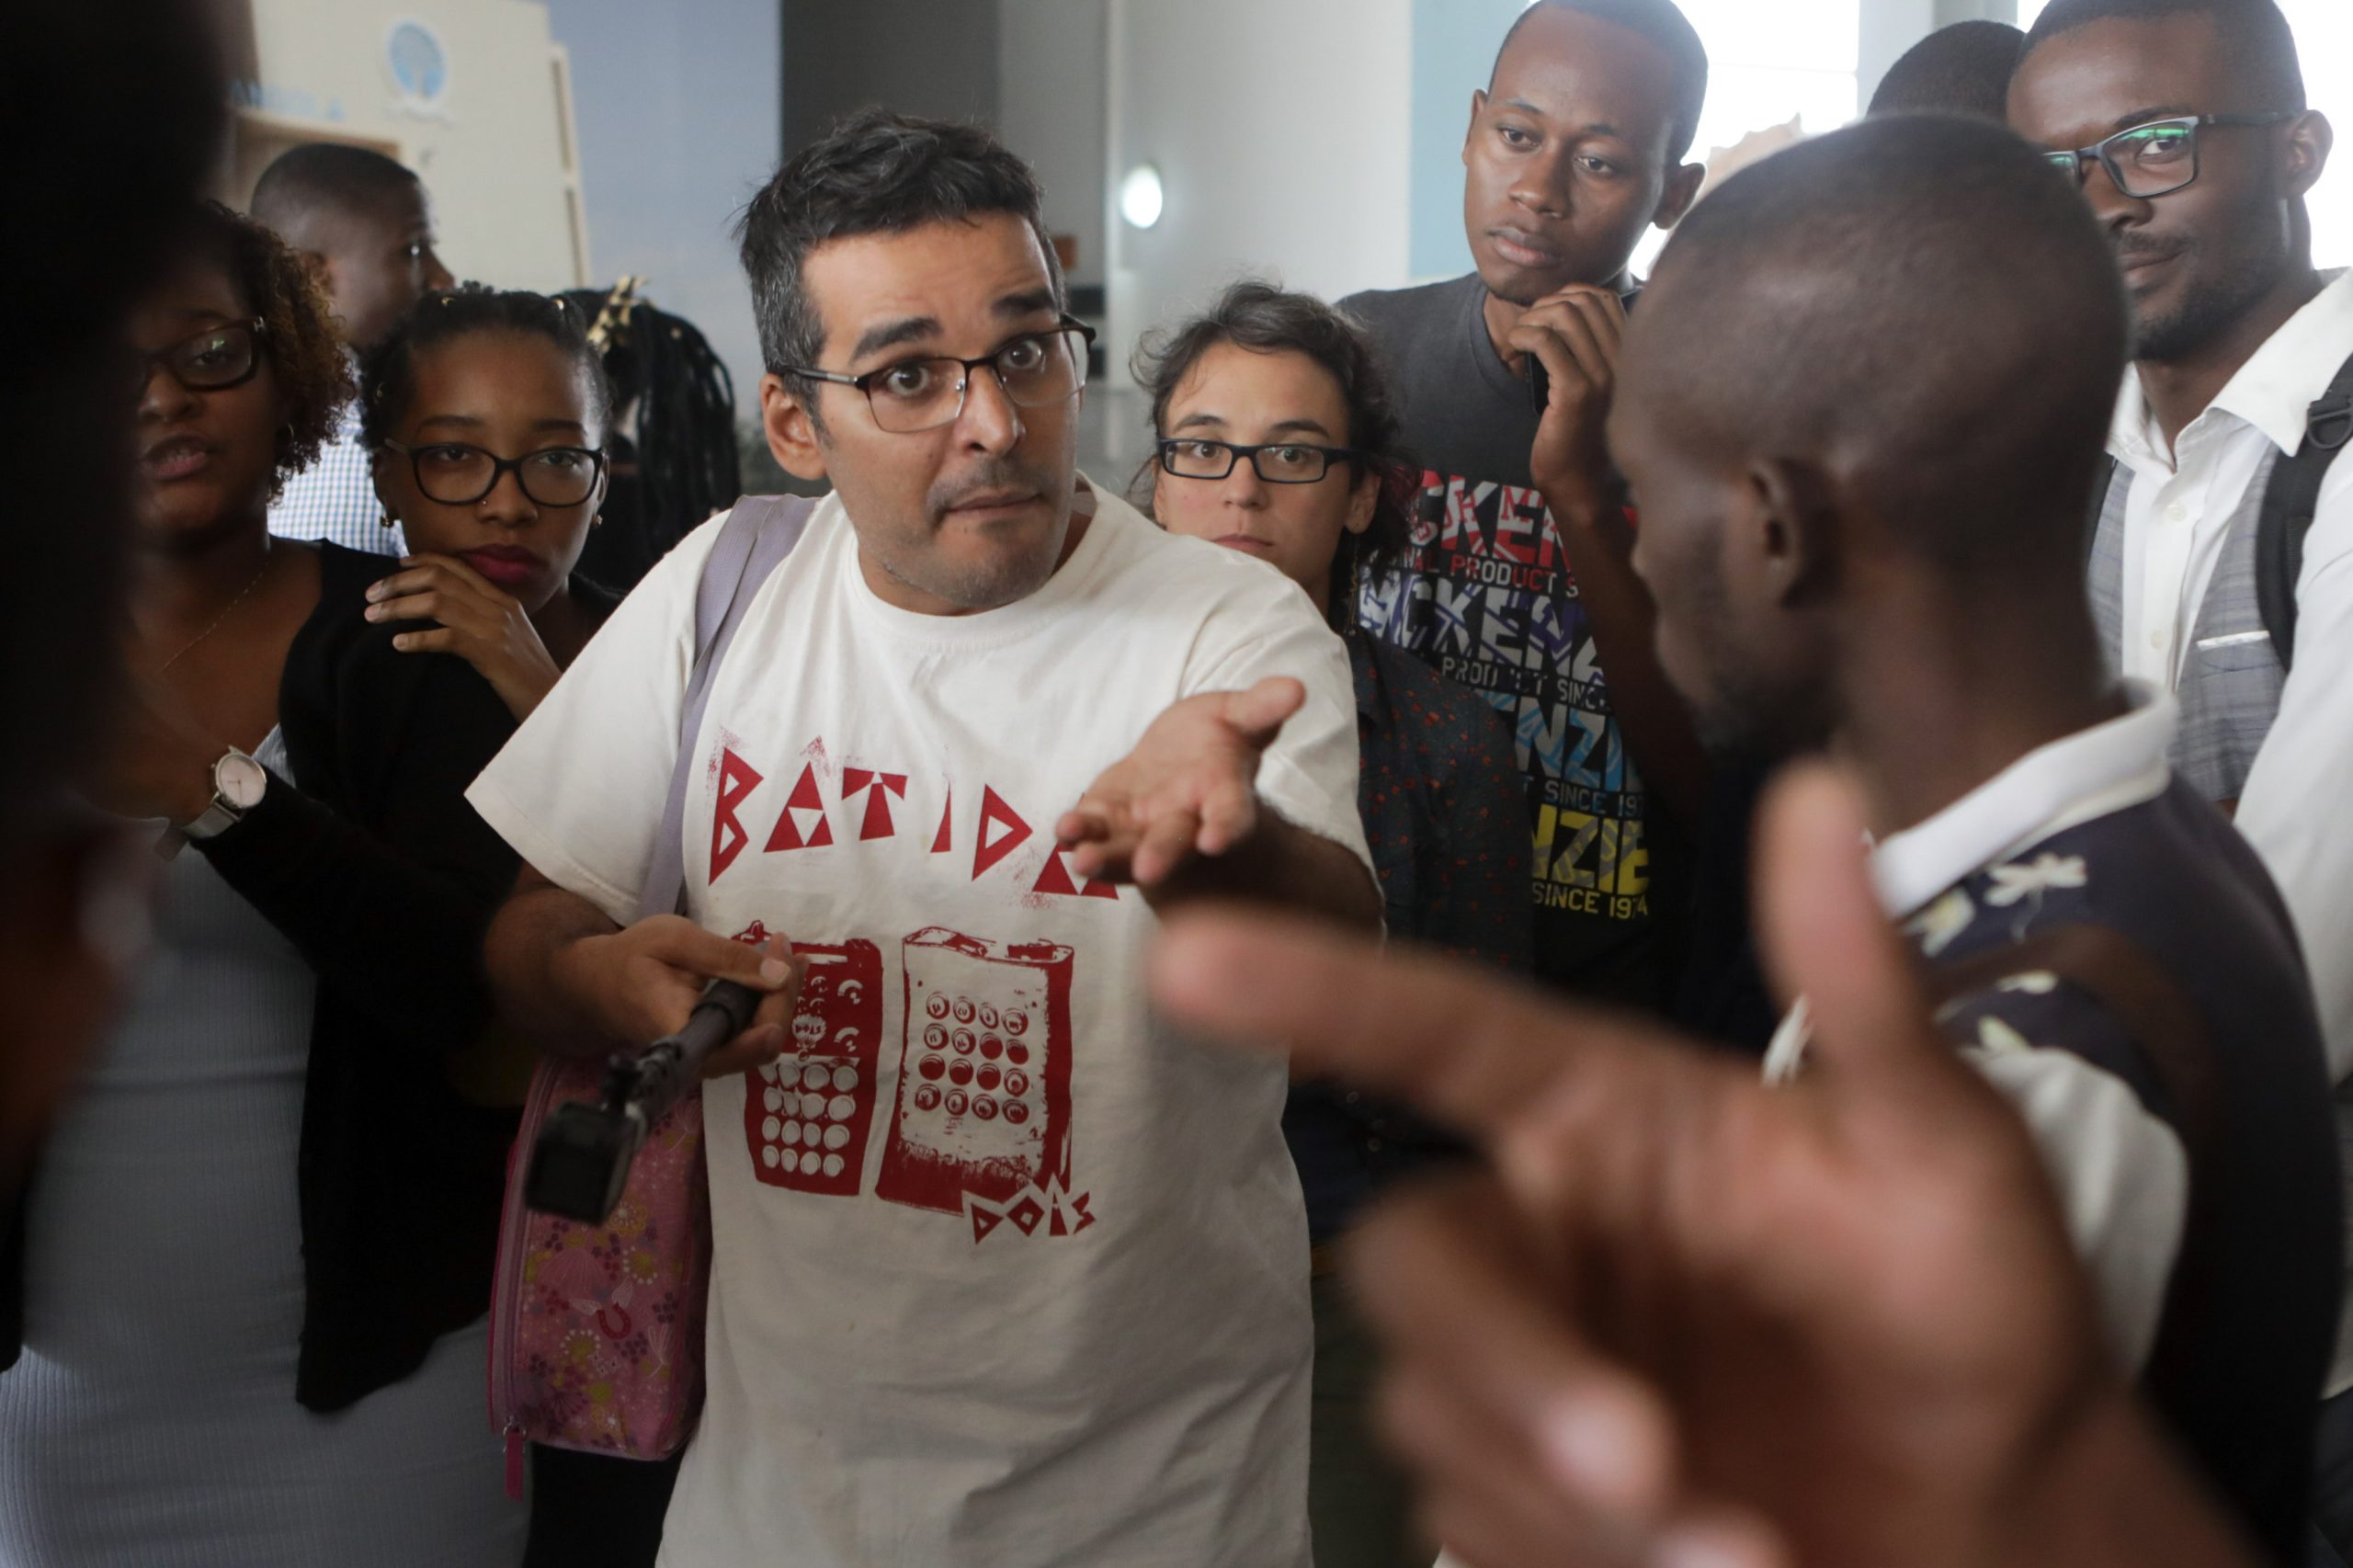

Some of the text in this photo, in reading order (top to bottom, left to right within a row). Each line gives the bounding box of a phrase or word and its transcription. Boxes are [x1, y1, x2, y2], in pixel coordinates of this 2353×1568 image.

[1449, 554, 1558, 594] PRODUCT
[1544, 779, 1607, 815] SINCE
[709, 735, 1120, 901] BATIDA
[1532, 881, 1601, 914] SINCE
[971, 1190, 1096, 1244] DOIS
